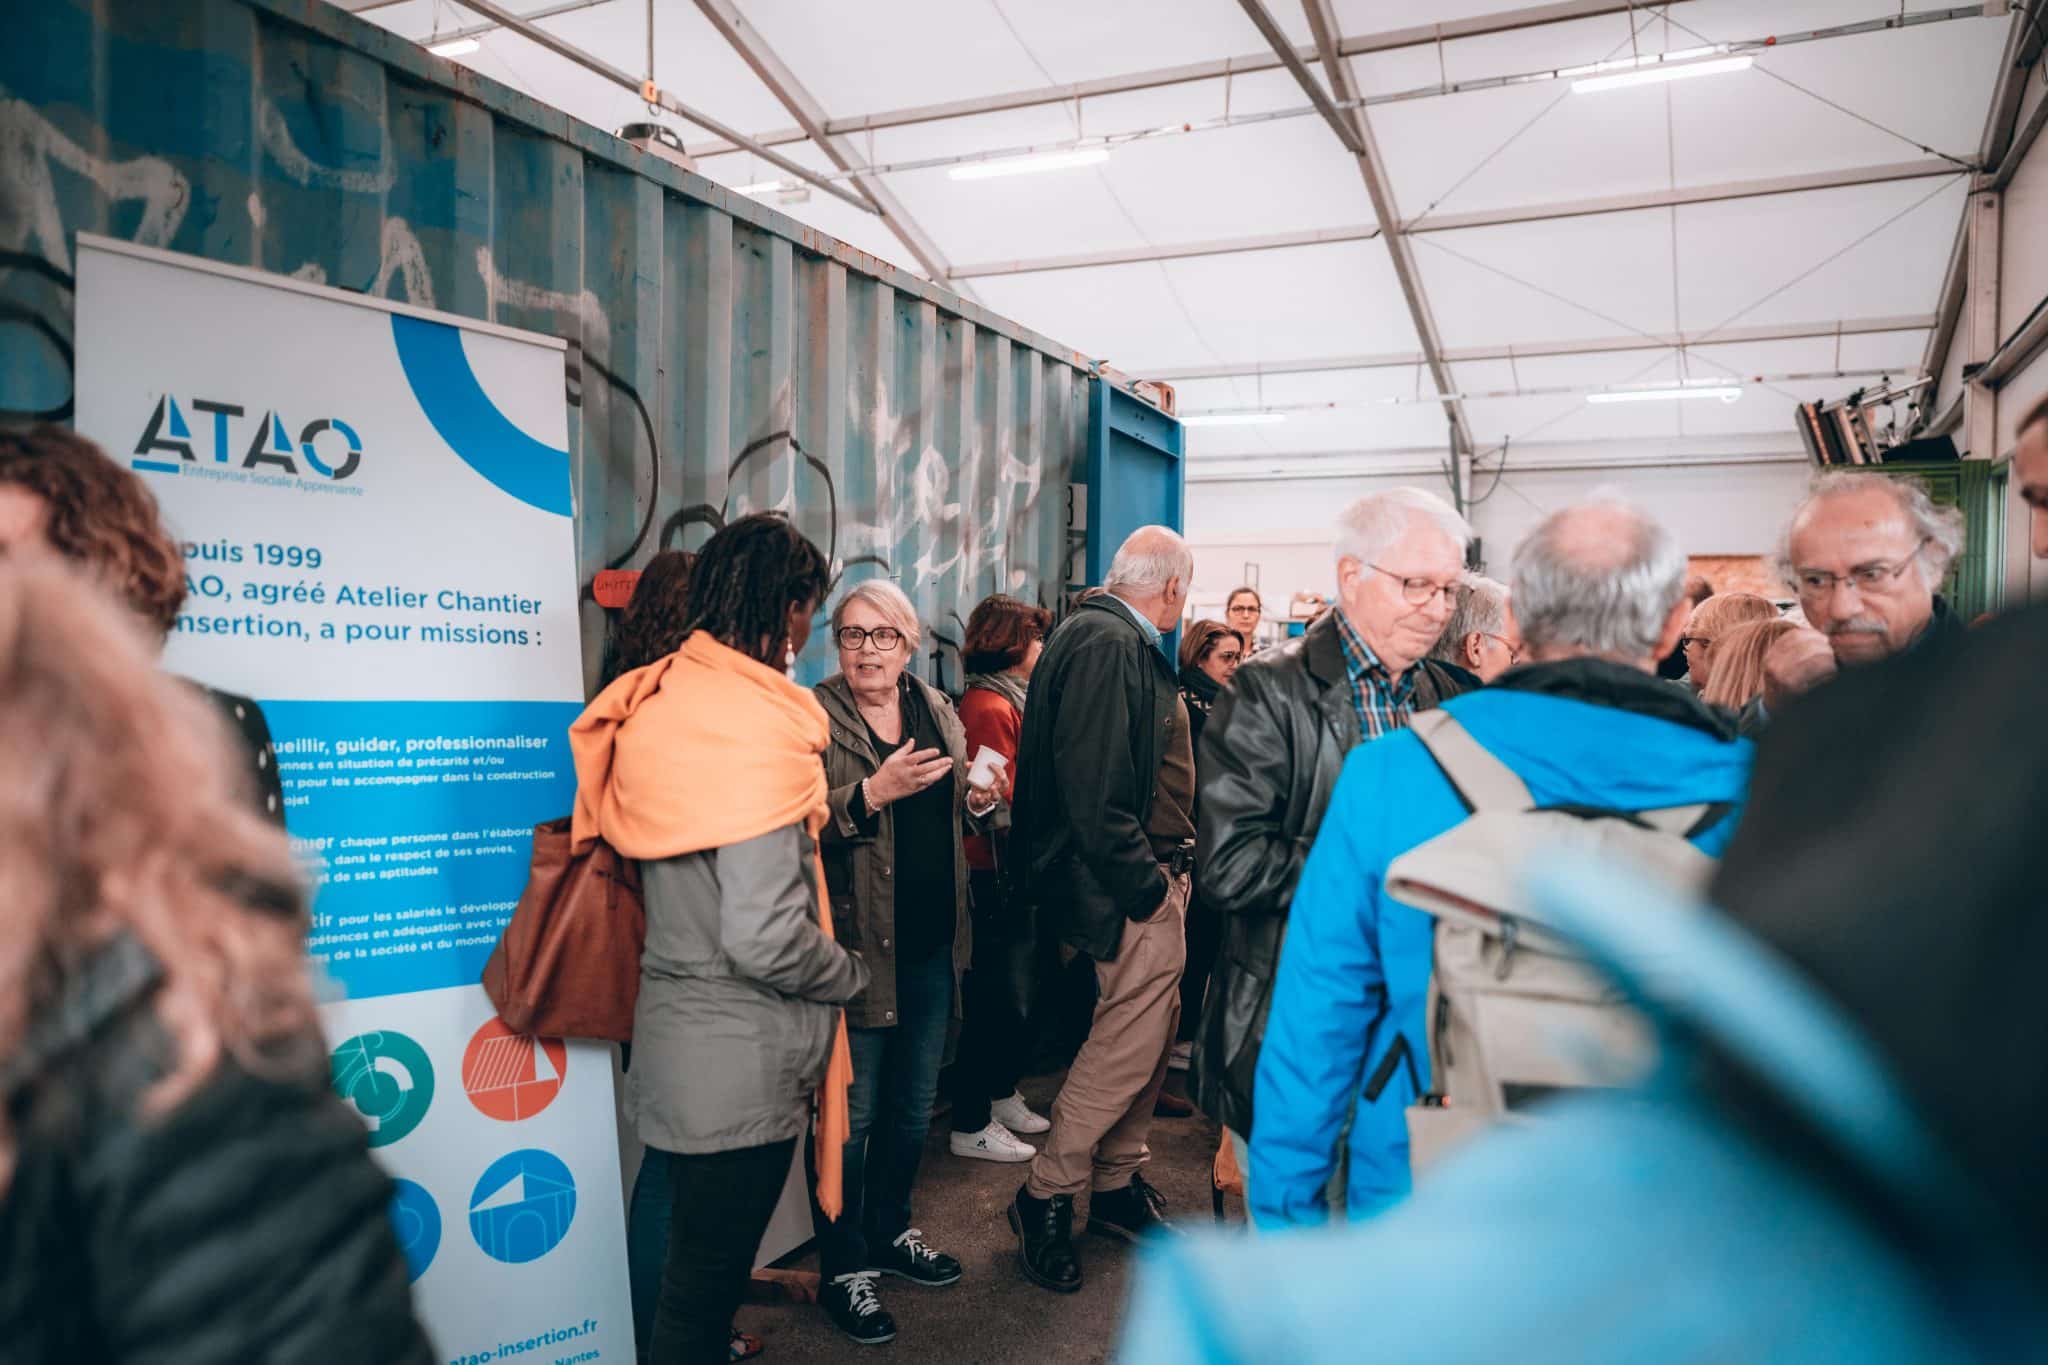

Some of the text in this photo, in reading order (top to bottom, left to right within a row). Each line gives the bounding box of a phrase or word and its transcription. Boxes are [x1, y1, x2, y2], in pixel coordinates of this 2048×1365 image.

[134, 393, 362, 480] ATAO
[183, 464, 363, 497] Entreprise Sociale Apprenante
[253, 543, 322, 569] 1999
[242, 580, 325, 605] agréé
[335, 583, 428, 608] Atelier
[437, 590, 542, 614] Chantier
[320, 621, 335, 640] a
[346, 623, 411, 644] pour
[421, 622, 529, 646] missions
[536, 631, 542, 646] :
[266, 735, 549, 755] ueillir, guider, professionnaliser
[317, 761, 334, 771] en
[337, 758, 395, 769] situation
[397, 757, 413, 768] de
[417, 755, 470, 768] précarité
[473, 754, 505, 766] et/ou
[297, 778, 328, 790] pour
[331, 775, 350, 786] les
[354, 773, 439, 786] accompagner
[442, 771, 470, 782] dans
[473, 771, 484, 781] la
[486, 769, 556, 780] construction
[340, 837, 388, 848] chaque
[391, 832, 449, 846] personne
[451, 829, 479, 841] dans
[482, 826, 534, 838] l'élabora
[334, 854, 366, 865] dans
[369, 852, 381, 862] le
[385, 849, 431, 862] respect
[434, 847, 450, 858] de
[454, 846, 472, 857] ses
[334, 871, 351, 882] de
[354, 870, 376, 881] ses
[380, 866, 439, 880] aptitudes
[339, 914, 369, 927] pour
[373, 911, 392, 922] les
[395, 907, 442, 920] salariés
[445, 904, 456, 915] le
[373, 929, 389, 939] en
[393, 921, 462, 937] adéquation
[465, 919, 493, 930] avec
[334, 949, 351, 960] de
[354, 946, 367, 958] la
[371, 942, 417, 957] société
[421, 940, 433, 951] et
[436, 938, 453, 949] du
[455, 933, 497, 947] monde
